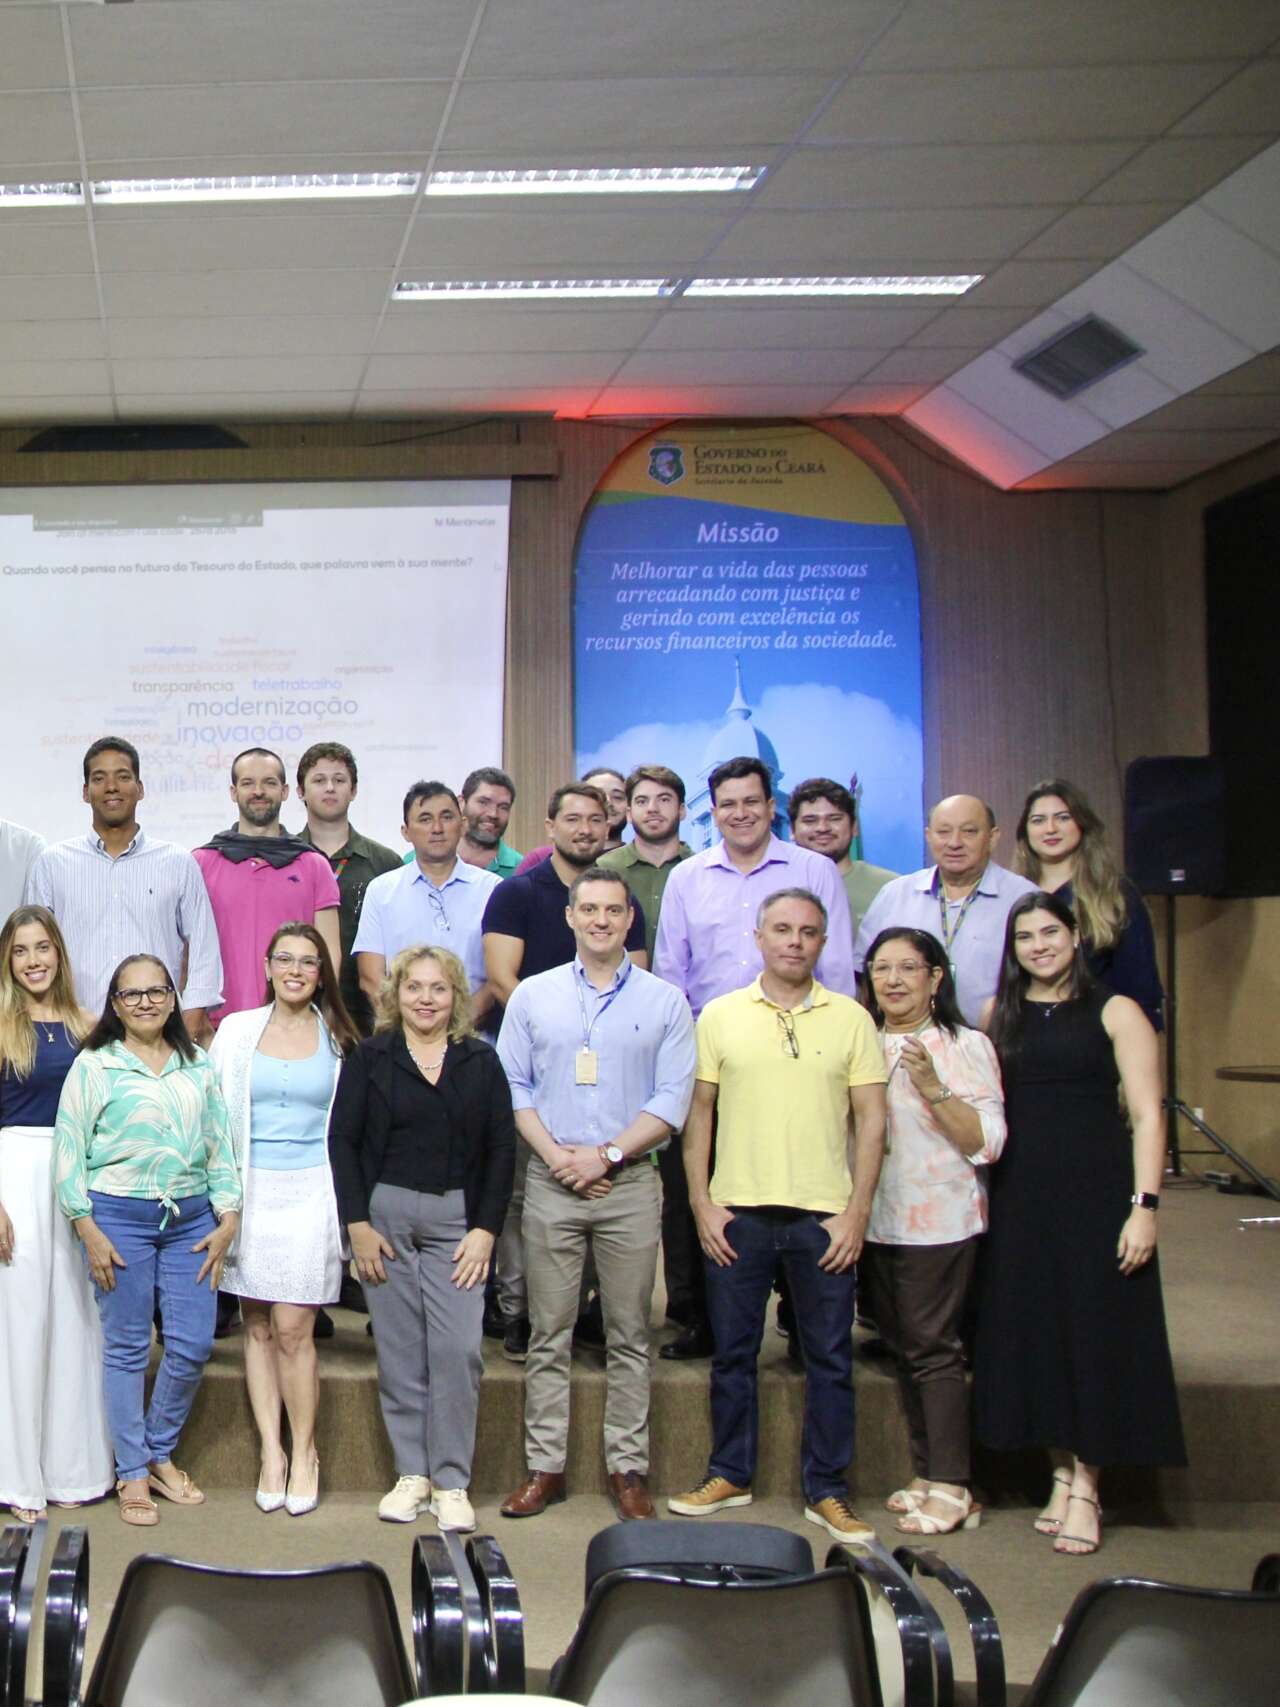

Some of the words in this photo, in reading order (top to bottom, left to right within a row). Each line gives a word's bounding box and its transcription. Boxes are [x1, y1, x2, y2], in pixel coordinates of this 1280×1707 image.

[694, 445, 767, 459] GOVERNO
[695, 460, 752, 474] ESTADO
[755, 464, 773, 473] DO
[697, 522, 780, 543] Missão
[2, 564, 49, 576] Quando
[51, 564, 79, 575] você
[81, 564, 116, 575] pensa
[135, 562, 170, 573] futuro
[190, 561, 236, 572] Tesouro
[237, 560, 253, 571] do
[300, 561, 321, 573] que
[324, 559, 369, 572] palavra
[371, 560, 396, 570] vem
[407, 560, 428, 569] sua
[430, 557, 473, 568] mente?
[612, 561, 698, 580] Melhorar
[702, 566, 713, 578] a
[720, 560, 759, 578] vida
[763, 560, 795, 578] das
[799, 562, 868, 583] pessoas
[616, 585, 736, 603] arrecadando
[741, 588, 779, 602] com
[781, 584, 846, 606] justiça
[850, 587, 860, 600] e
[620, 608, 692, 631] gerindo
[697, 611, 736, 626] com
[740, 607, 837, 627] excelência
[841, 611, 861, 625] os
[585, 636, 663, 651] recursos
[663, 631, 771, 654] financeiros
[774, 631, 799, 650] da
[802, 629, 897, 649] sociedade.
[132, 678, 234, 697] transparência
[253, 677, 343, 691] teletrabalho
[187, 695, 359, 721] modernização
[178, 722, 304, 744] inovação
